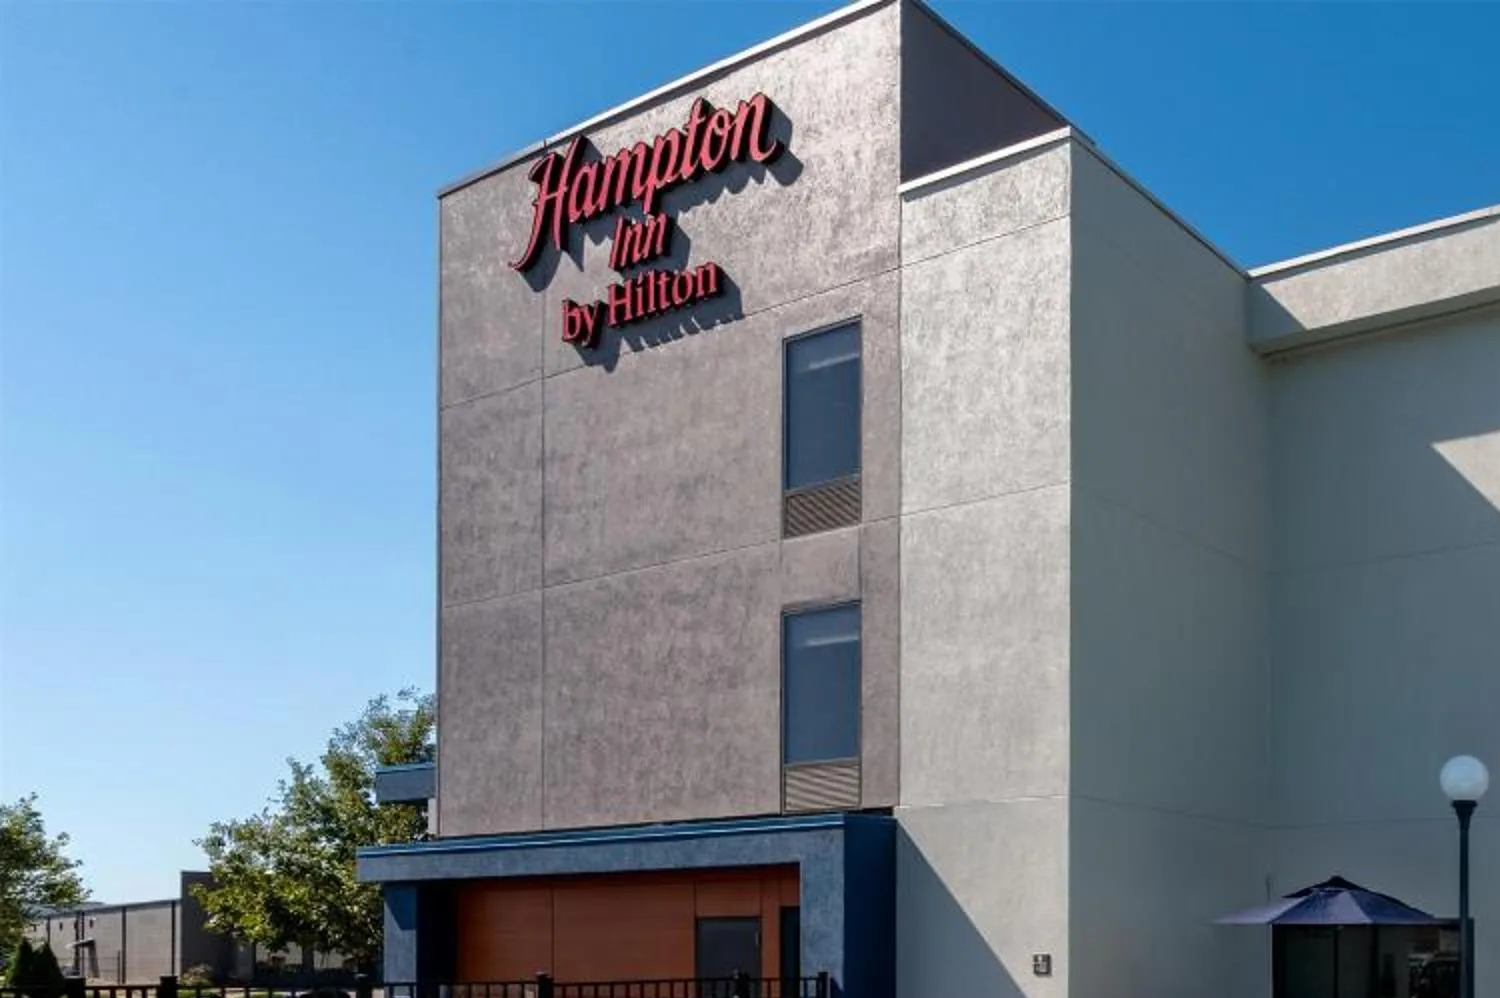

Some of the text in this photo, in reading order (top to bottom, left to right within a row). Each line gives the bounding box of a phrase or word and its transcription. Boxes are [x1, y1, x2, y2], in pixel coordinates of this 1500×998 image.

[507, 92, 780, 272] Hampton
[608, 213, 670, 271] Inn
[562, 261, 726, 347] by Hilton
